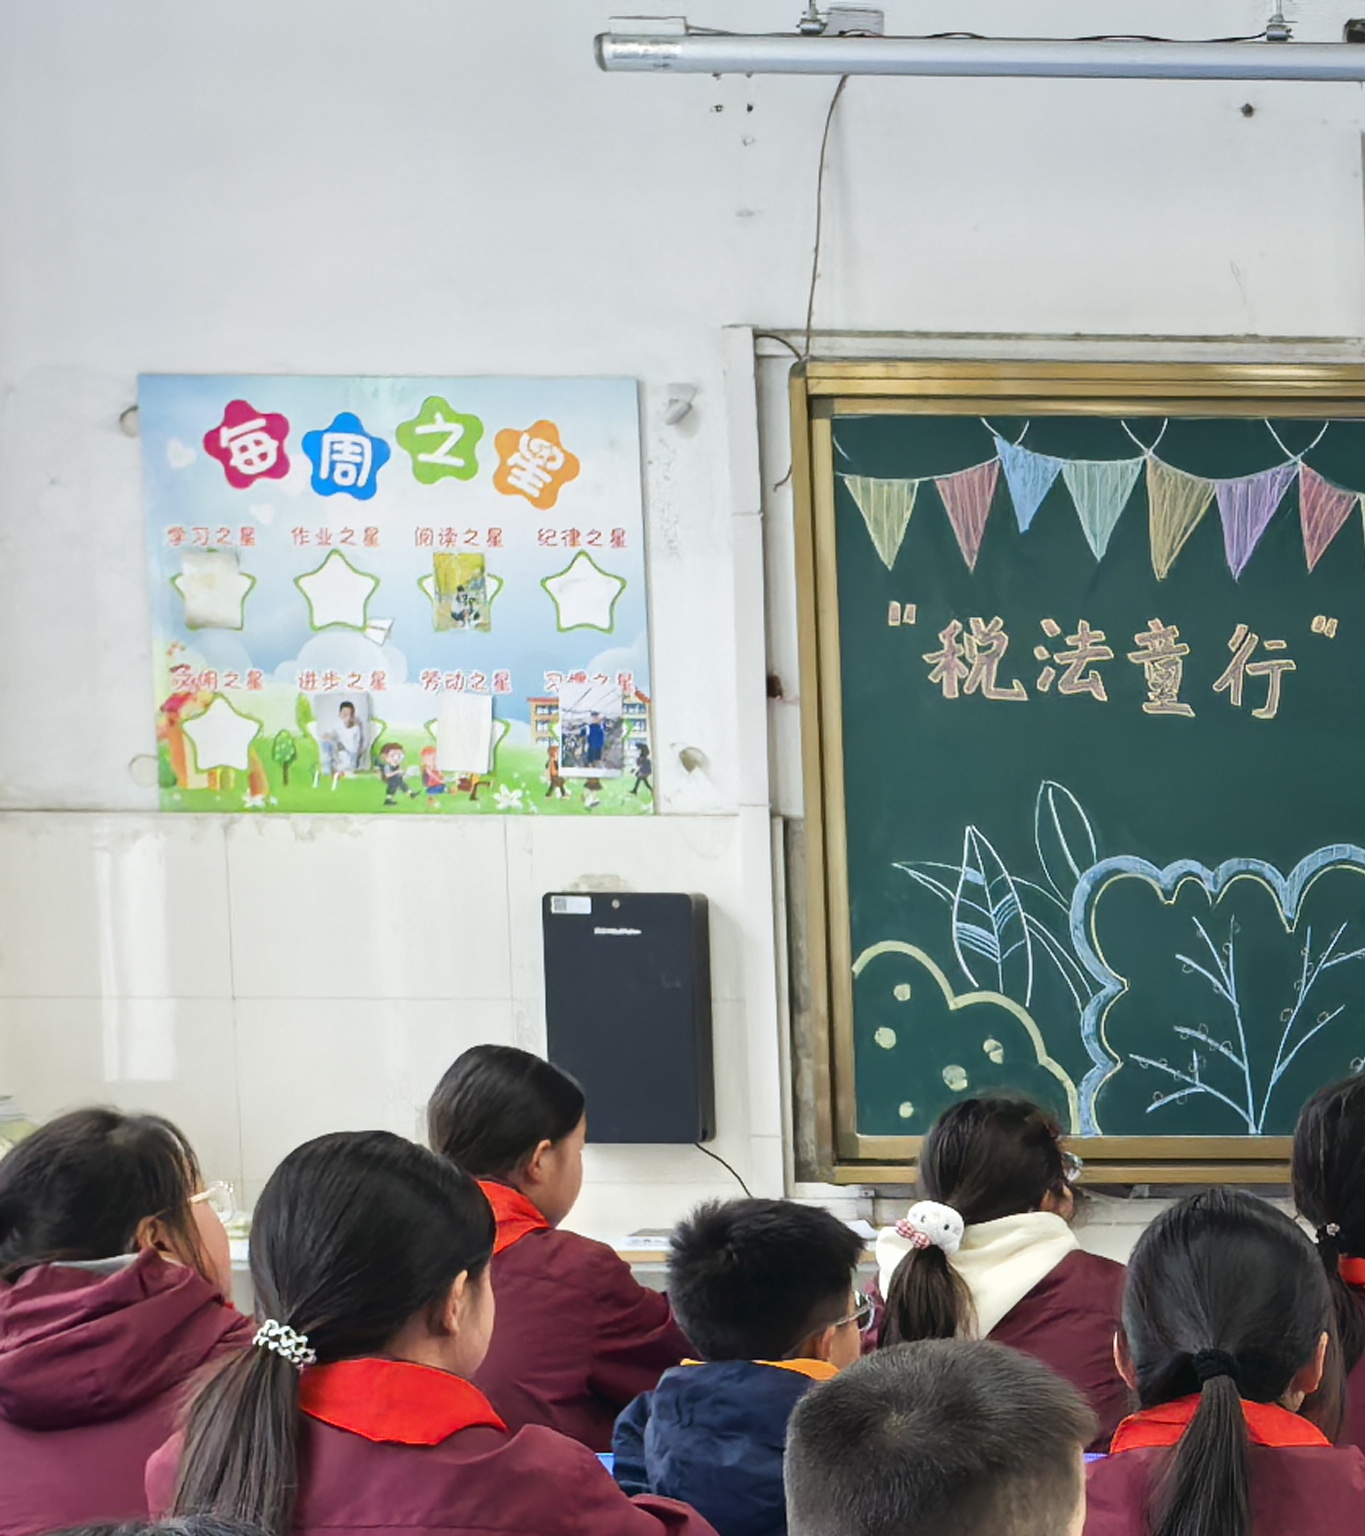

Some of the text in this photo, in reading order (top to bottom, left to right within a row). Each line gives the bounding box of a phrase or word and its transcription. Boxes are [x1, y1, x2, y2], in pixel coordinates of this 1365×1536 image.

[219, 412, 564, 499] 每周之星
[167, 526, 256, 547] 学习之星
[291, 526, 379, 547] 作业之星
[414, 526, 503, 548] 阅读之星
[537, 527, 627, 548] 纪律之星
[299, 671, 387, 691] 进步之星
[421, 671, 511, 692] 劳动之星
